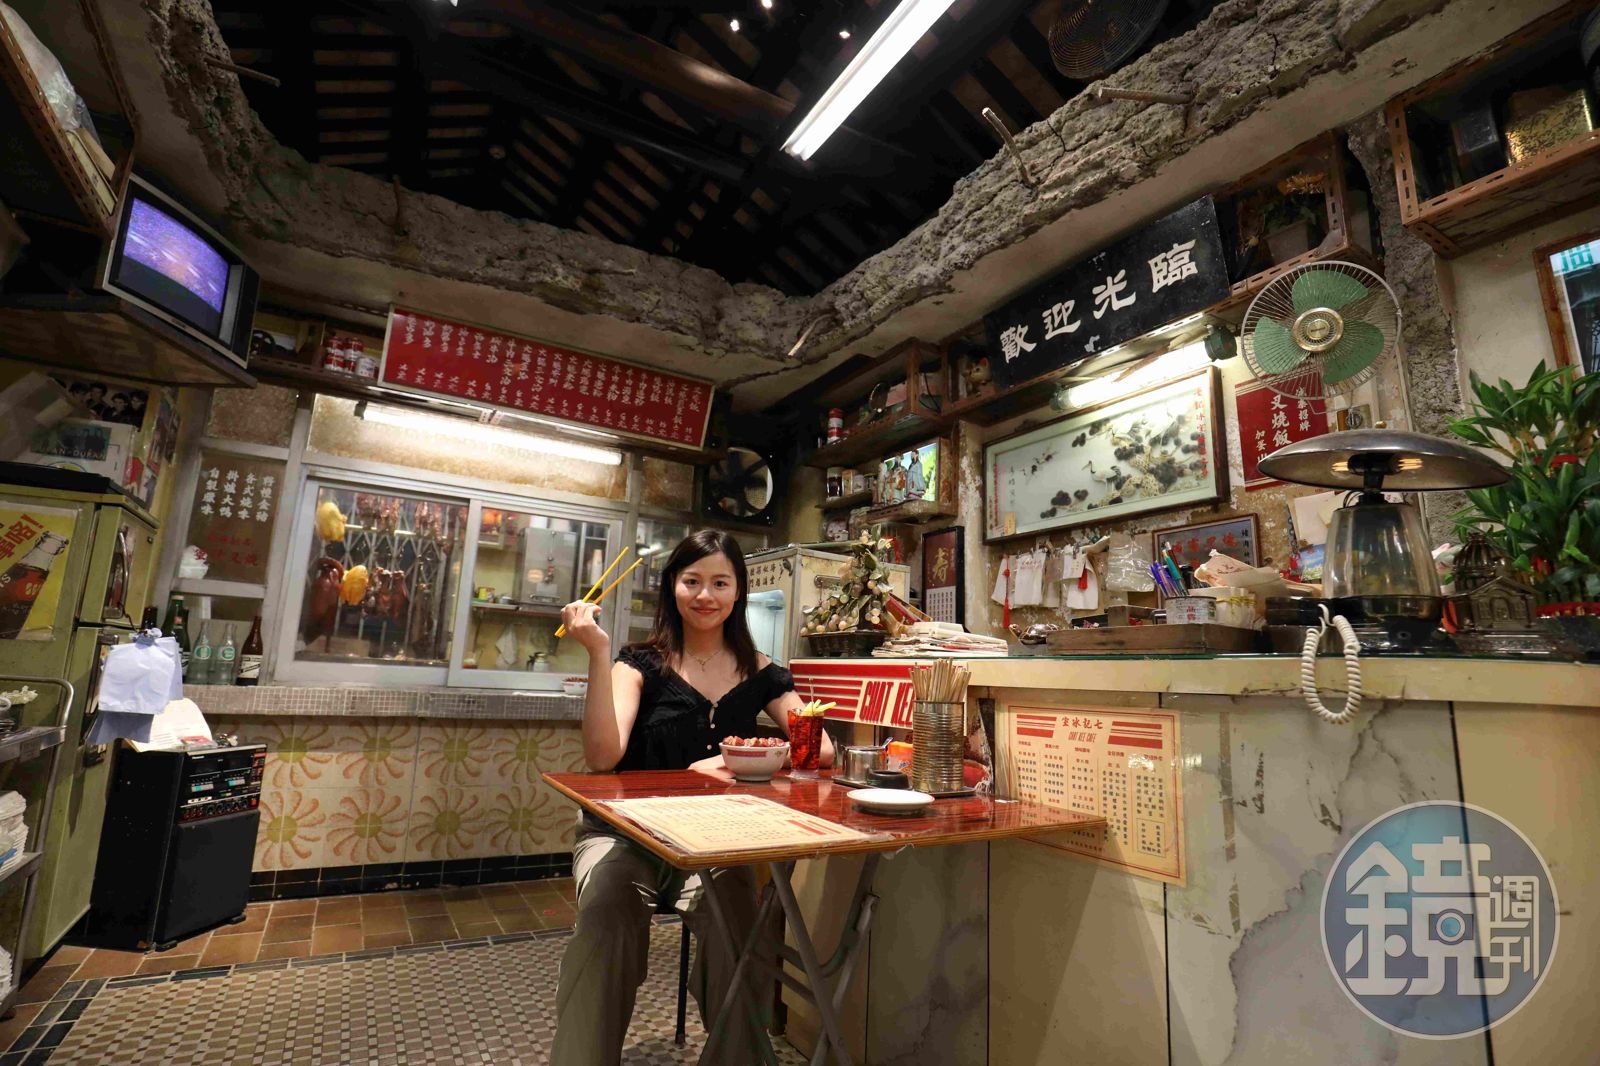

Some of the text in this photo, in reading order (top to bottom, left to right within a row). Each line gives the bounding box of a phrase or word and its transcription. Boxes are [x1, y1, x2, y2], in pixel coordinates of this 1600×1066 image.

[1000, 239, 1199, 363] 歡迎光臨
[1270, 395, 1292, 447] 叉燒飯
[860, 681, 894, 723] CHAT
